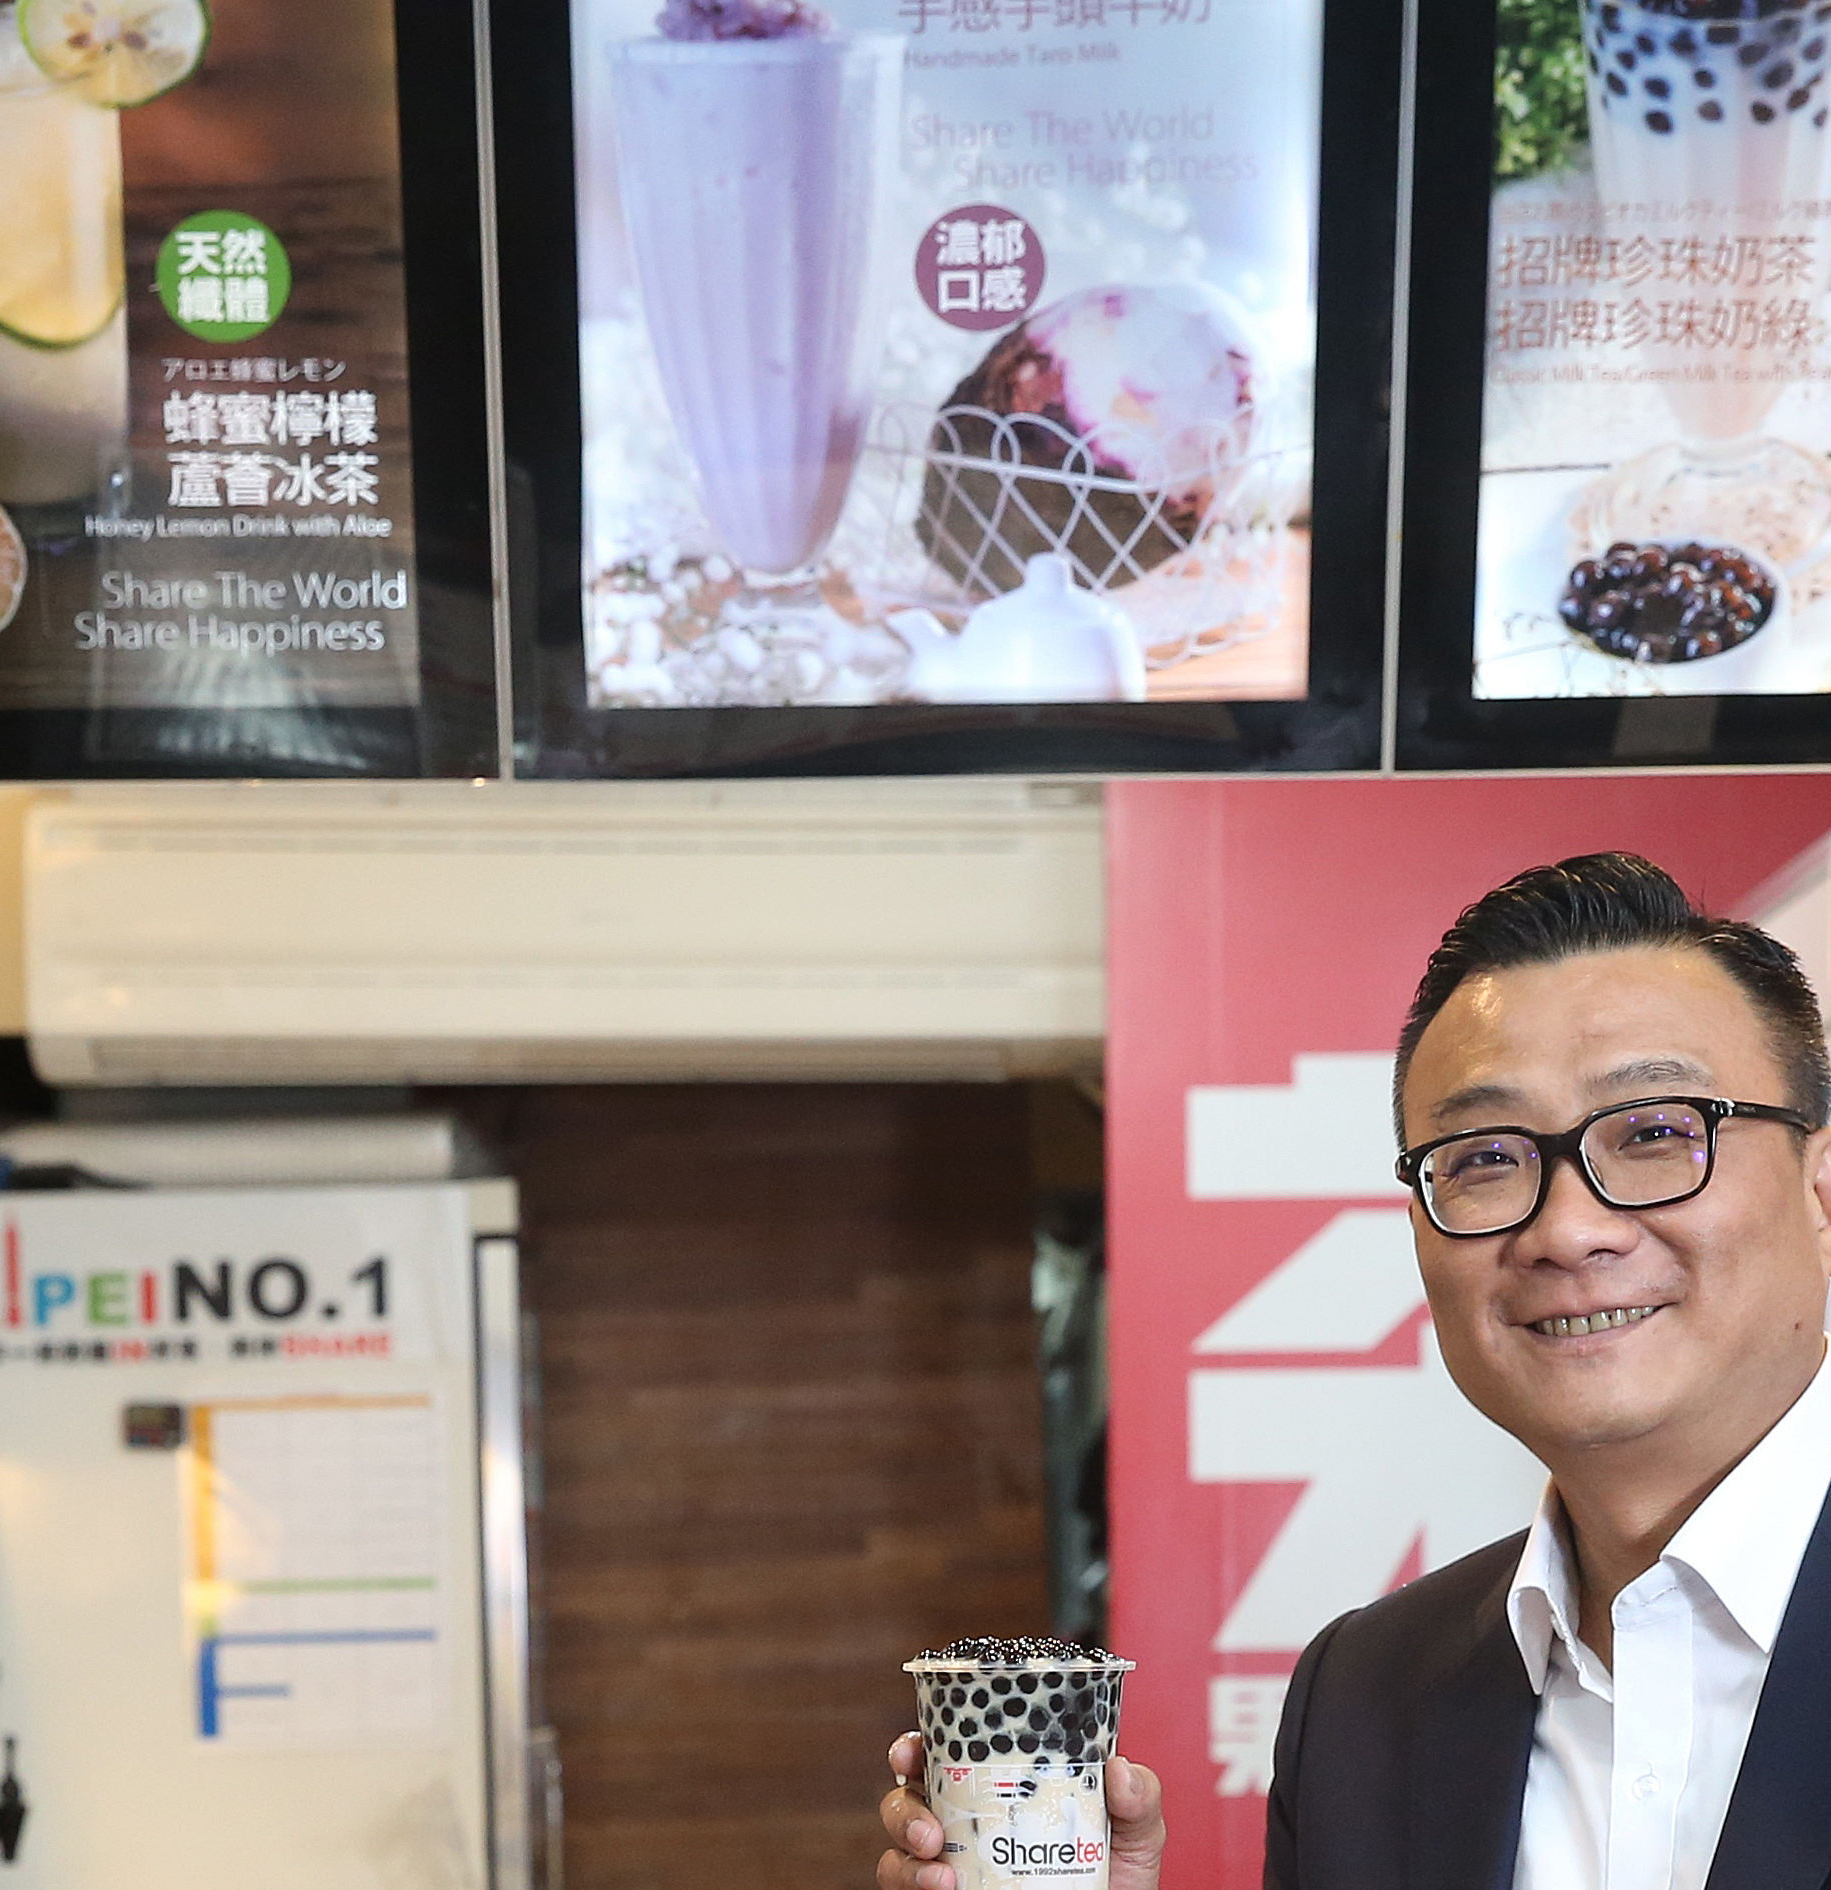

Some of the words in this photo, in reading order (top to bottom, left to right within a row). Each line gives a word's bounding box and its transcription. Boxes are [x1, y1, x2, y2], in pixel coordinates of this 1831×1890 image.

[1025, 44, 1073, 66] Taro
[910, 113, 1015, 150] Share
[1024, 109, 1095, 147] The
[1101, 106, 1215, 143] World
[952, 154, 1057, 192] Share
[1069, 152, 1260, 188] Happiness
[174, 229, 267, 276] 天然
[935, 219, 1027, 266] 濃郁
[1496, 234, 1816, 288] 招牌珍珠奶茶
[935, 268, 1027, 314] 口感
[1495, 297, 1812, 357] 招牌珍珠奶綠
[162, 390, 378, 446] 蜂蜜檸檬
[167, 450, 379, 507] 蘆薈冰茶
[85, 515, 154, 542] Honey
[156, 515, 229, 538] Lemon
[233, 514, 289, 538] Drink
[292, 514, 340, 538] with
[343, 513, 392, 538] Aloe
[101, 570, 207, 609] Share
[216, 570, 286, 609] The
[293, 570, 408, 610] World
[73, 611, 180, 652] Share
[188, 613, 385, 657] Happiness
[175, 1256, 388, 1322] NO.1
[992, 1836, 1104, 1865] Sharetea
